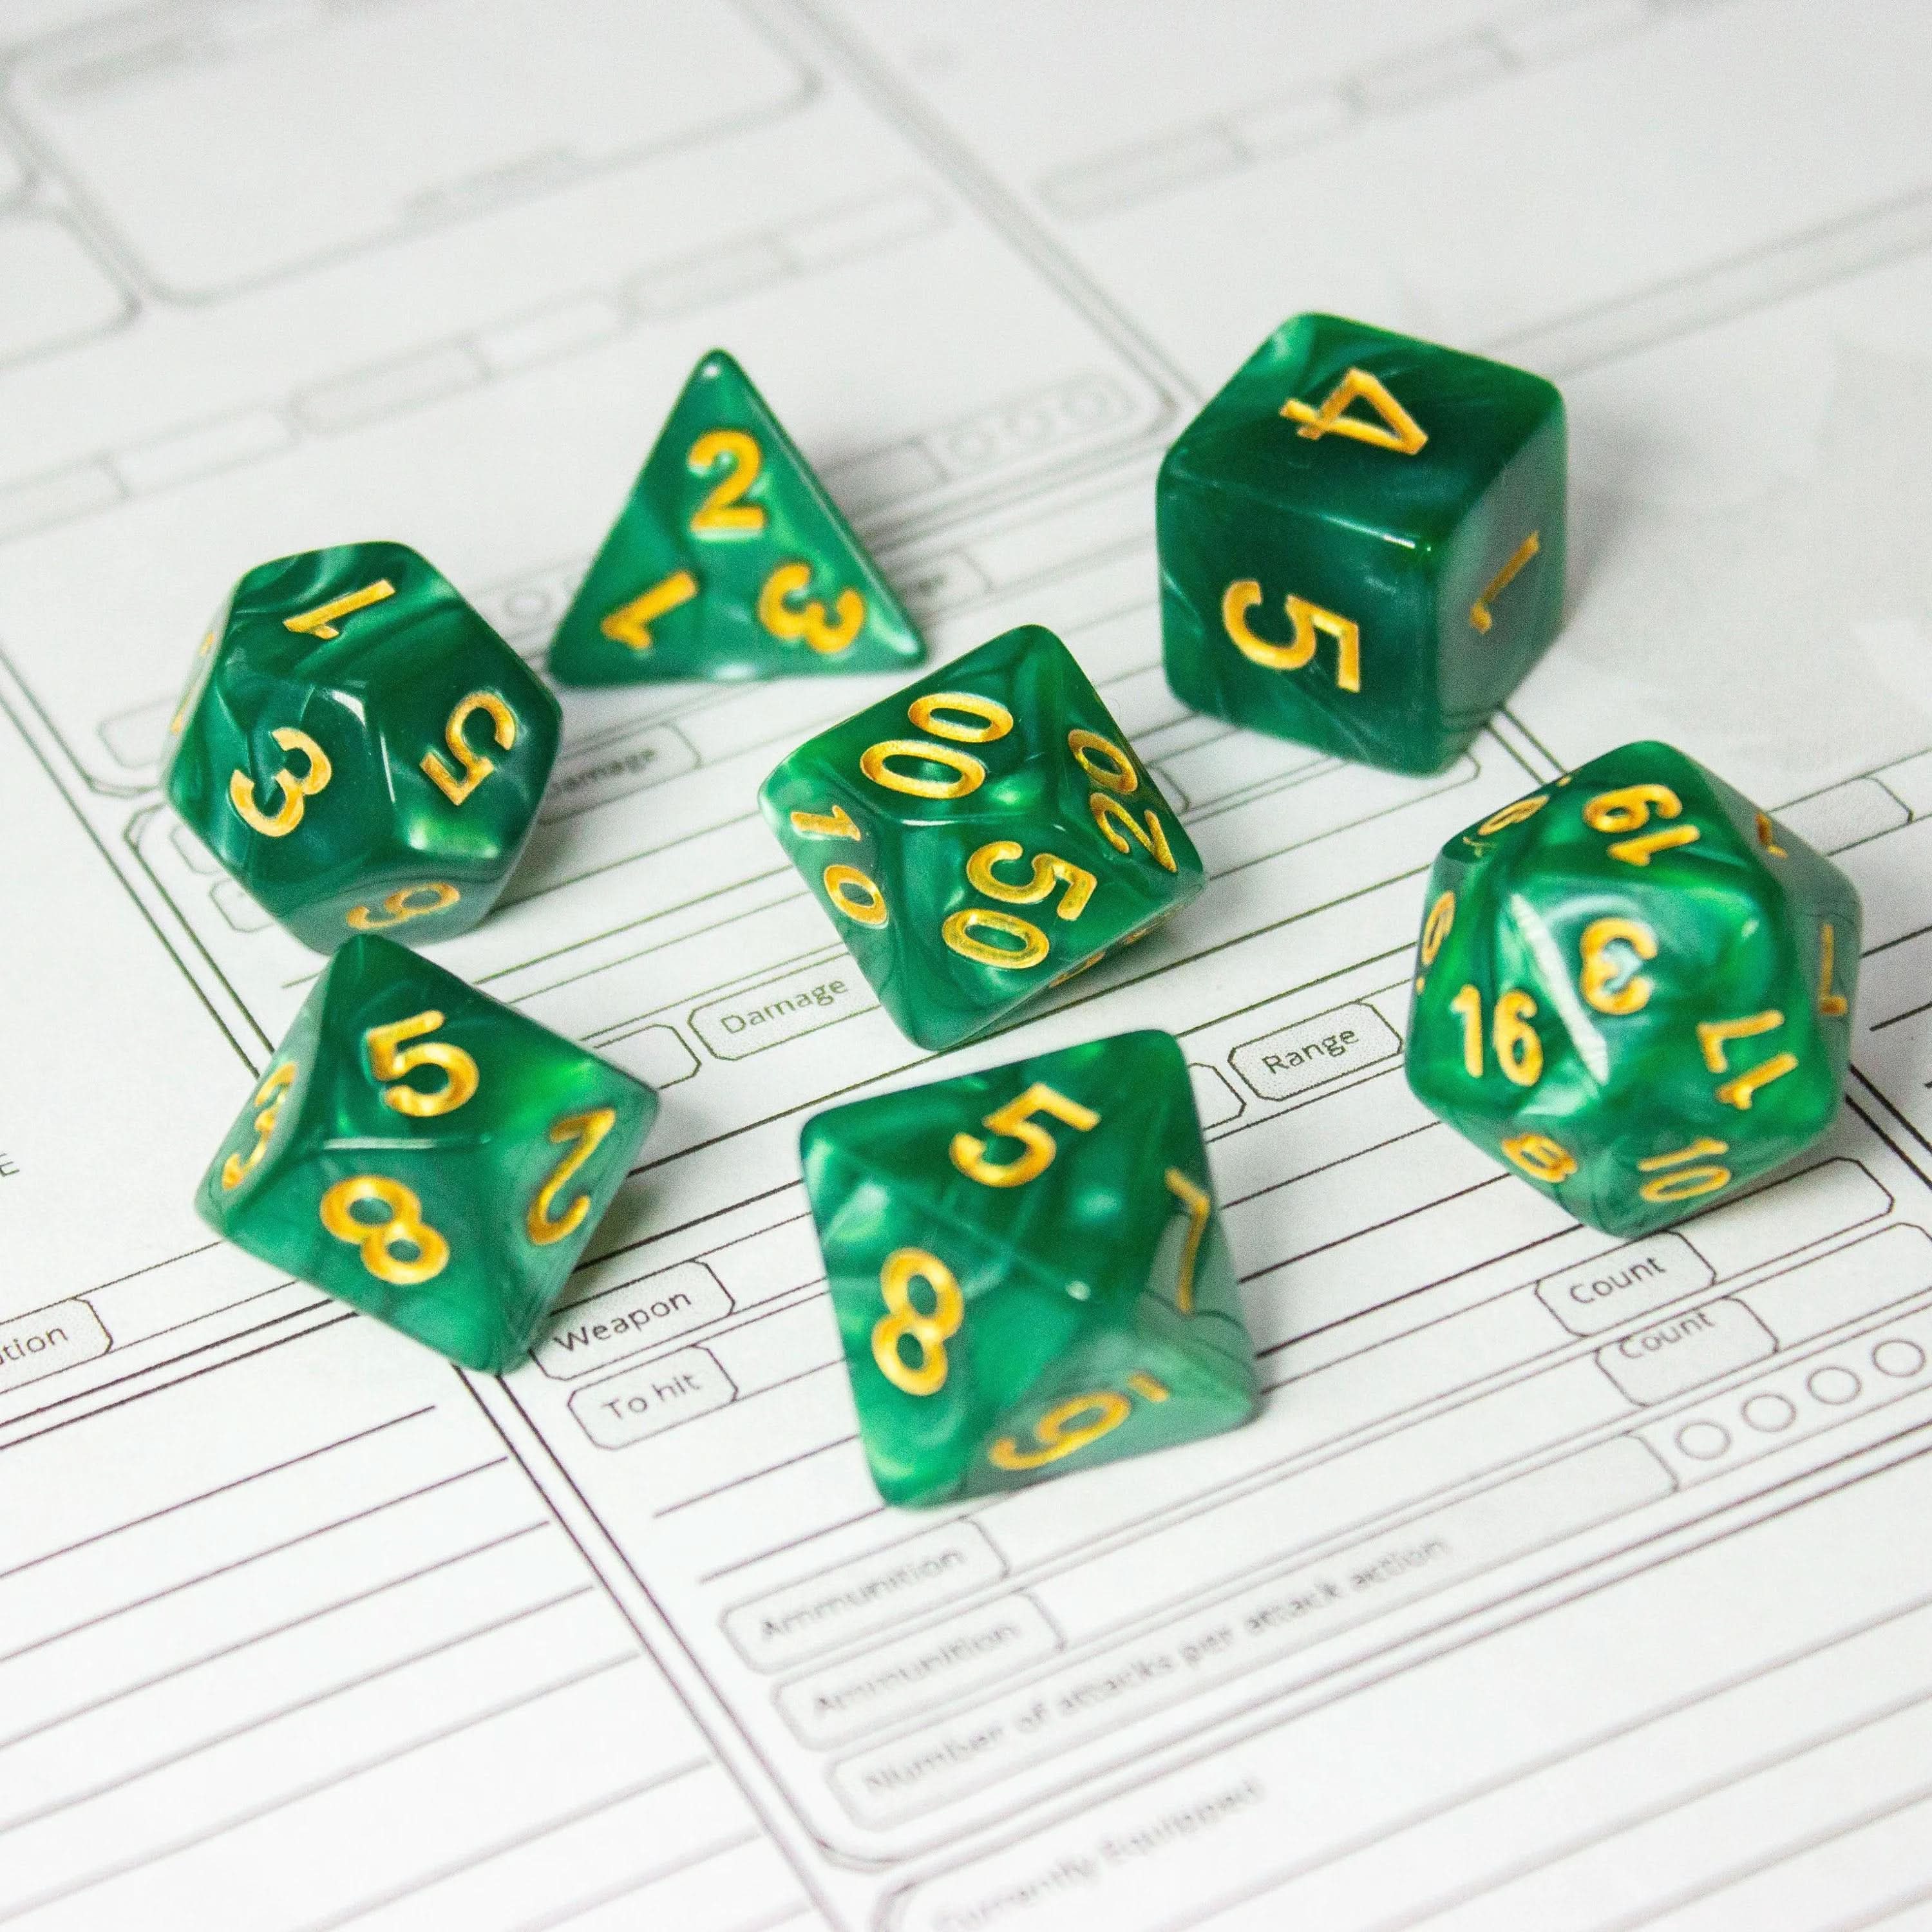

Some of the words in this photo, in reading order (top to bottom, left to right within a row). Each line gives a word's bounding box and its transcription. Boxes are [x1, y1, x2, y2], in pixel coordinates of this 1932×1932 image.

[1280, 367, 1428, 455] 4
[687, 429, 766, 532] 2
[283, 579, 395, 639] 1
[601, 570, 698, 650] 1
[758, 562, 866, 654] 3
[1468, 530, 1540, 634] 1
[1222, 579, 1361, 692] 5
[230, 727, 332, 837] 3
[421, 691, 516, 806] 5
[1583, 784, 1701, 866] 19
[719, 980, 849, 1035] Damage
[1580, 918, 1658, 1015] 3
[366, 1009, 480, 1117] 5
[1262, 1030, 1359, 1074] Range
[1452, 985, 1544, 1086] 16
[1698, 1010, 1798, 1110] 17
[950, 1083, 1100, 1187] 5
[1638, 1137, 1732, 1203] 10
[320, 1175, 450, 1284] 8
[553, 1293, 692, 1352] Weapon
[871, 1247, 963, 1396] 8
[1569, 1257, 1667, 1304] Count
[0, 1328, 68, 1365] tion
[1618, 1312, 1716, 1358] Count
[600, 1397, 648, 1420] To
[652, 1374, 701, 1401] hit
[761, 1549, 965, 1639] Ammunition
